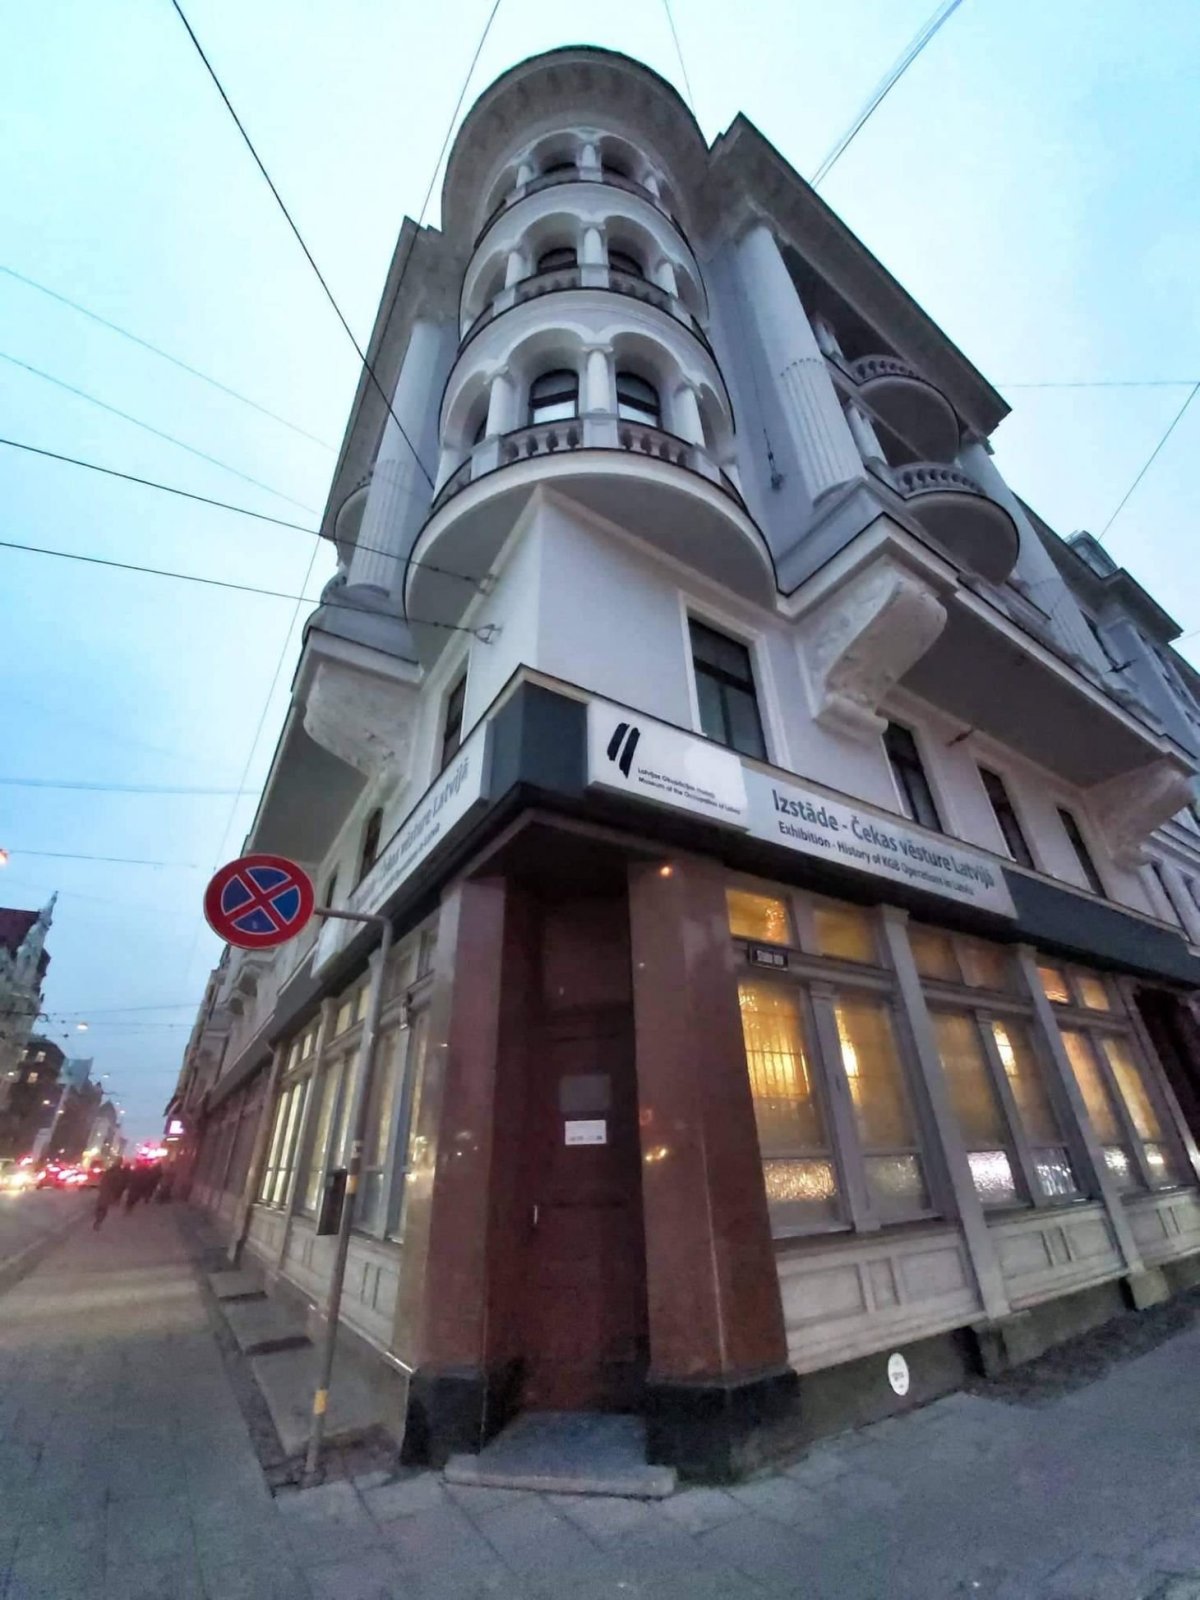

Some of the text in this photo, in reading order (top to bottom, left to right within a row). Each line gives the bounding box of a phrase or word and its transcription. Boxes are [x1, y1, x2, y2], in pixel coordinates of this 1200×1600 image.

[638, 777, 665, 789] Museum
[772, 789, 839, 831] Izstāde
[851, 814, 898, 852] Čekas
[898, 839, 952, 871] vēsture
[778, 820, 831, 848] Exhibition
[837, 841, 870, 864] History
[872, 854, 881, 865] of
